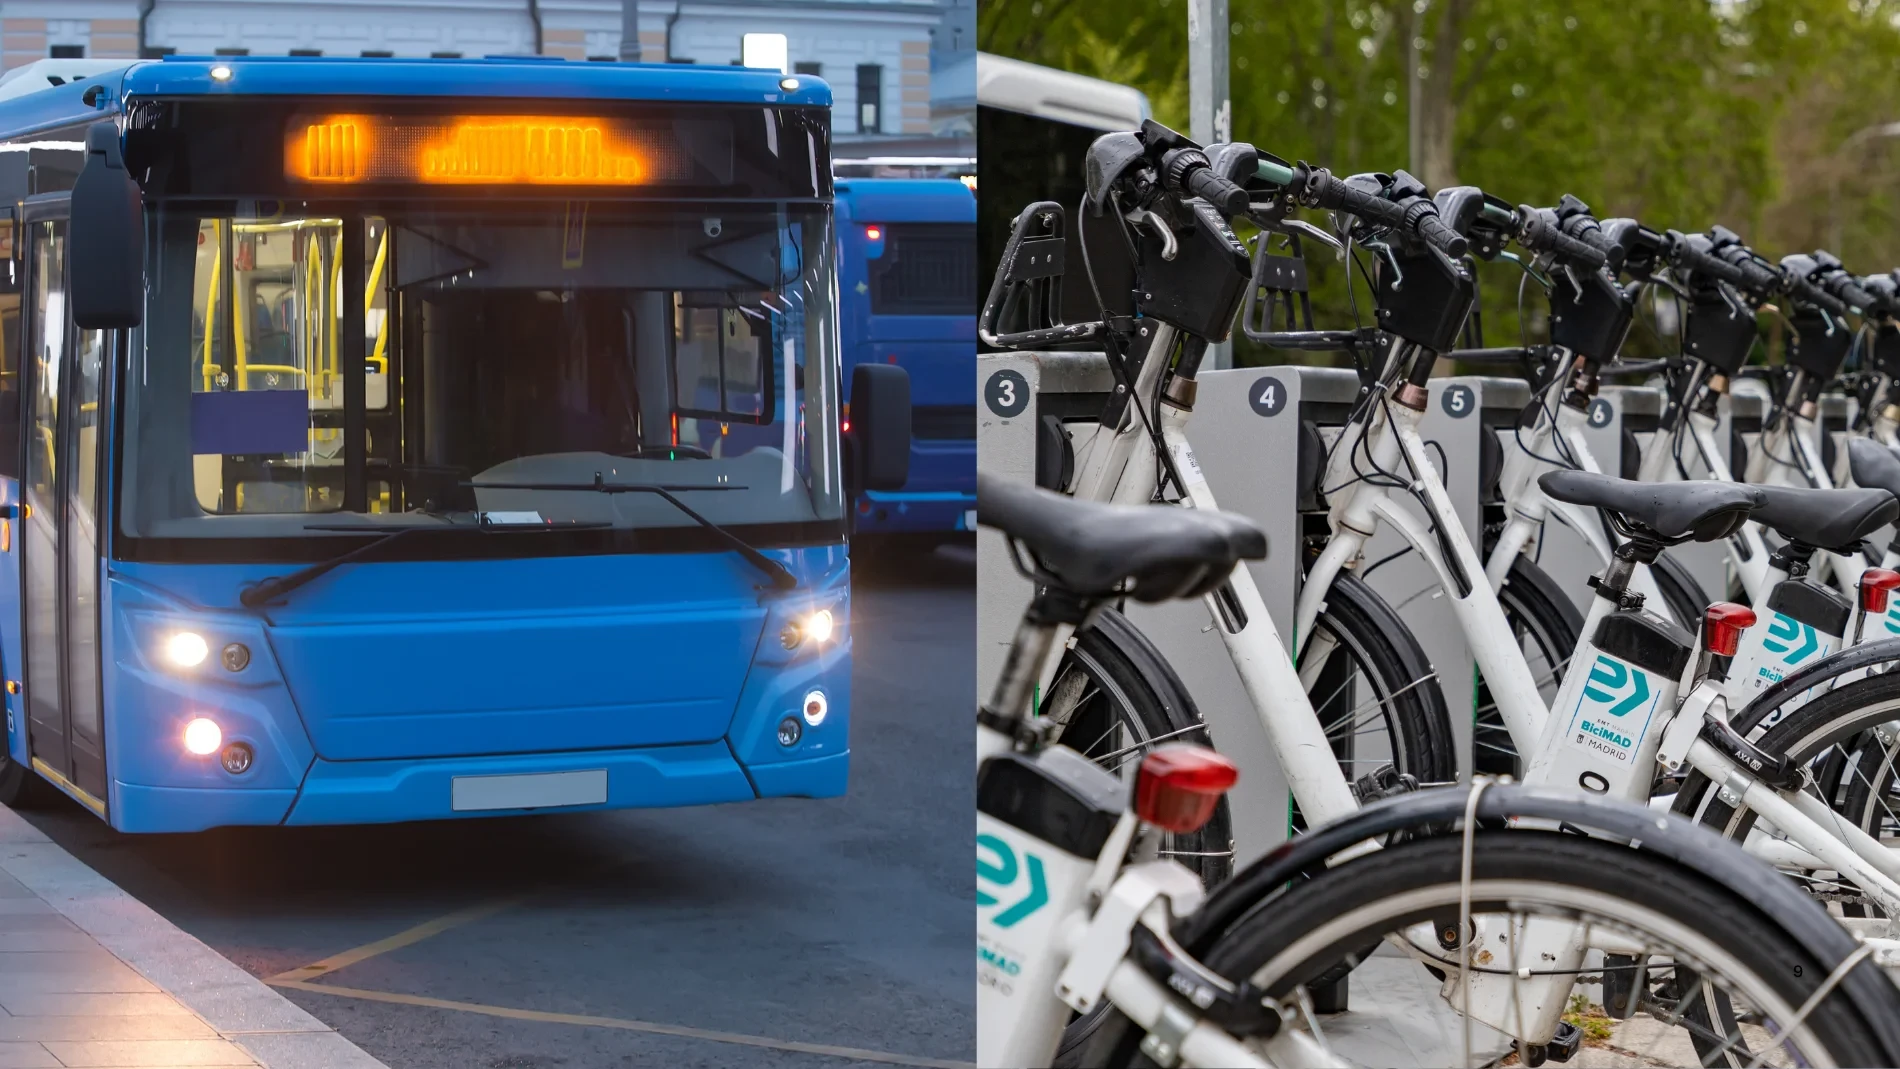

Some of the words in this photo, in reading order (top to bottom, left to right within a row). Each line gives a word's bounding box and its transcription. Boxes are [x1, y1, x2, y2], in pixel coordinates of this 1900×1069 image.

[997, 379, 1016, 407] 3
[1259, 385, 1275, 409] 4
[1451, 390, 1465, 412] 5
[1593, 402, 1604, 423] 6
[1581, 720, 1632, 748] BiciMAD
[1588, 739, 1627, 761] MADRID
[1734, 750, 1751, 765] AXA
